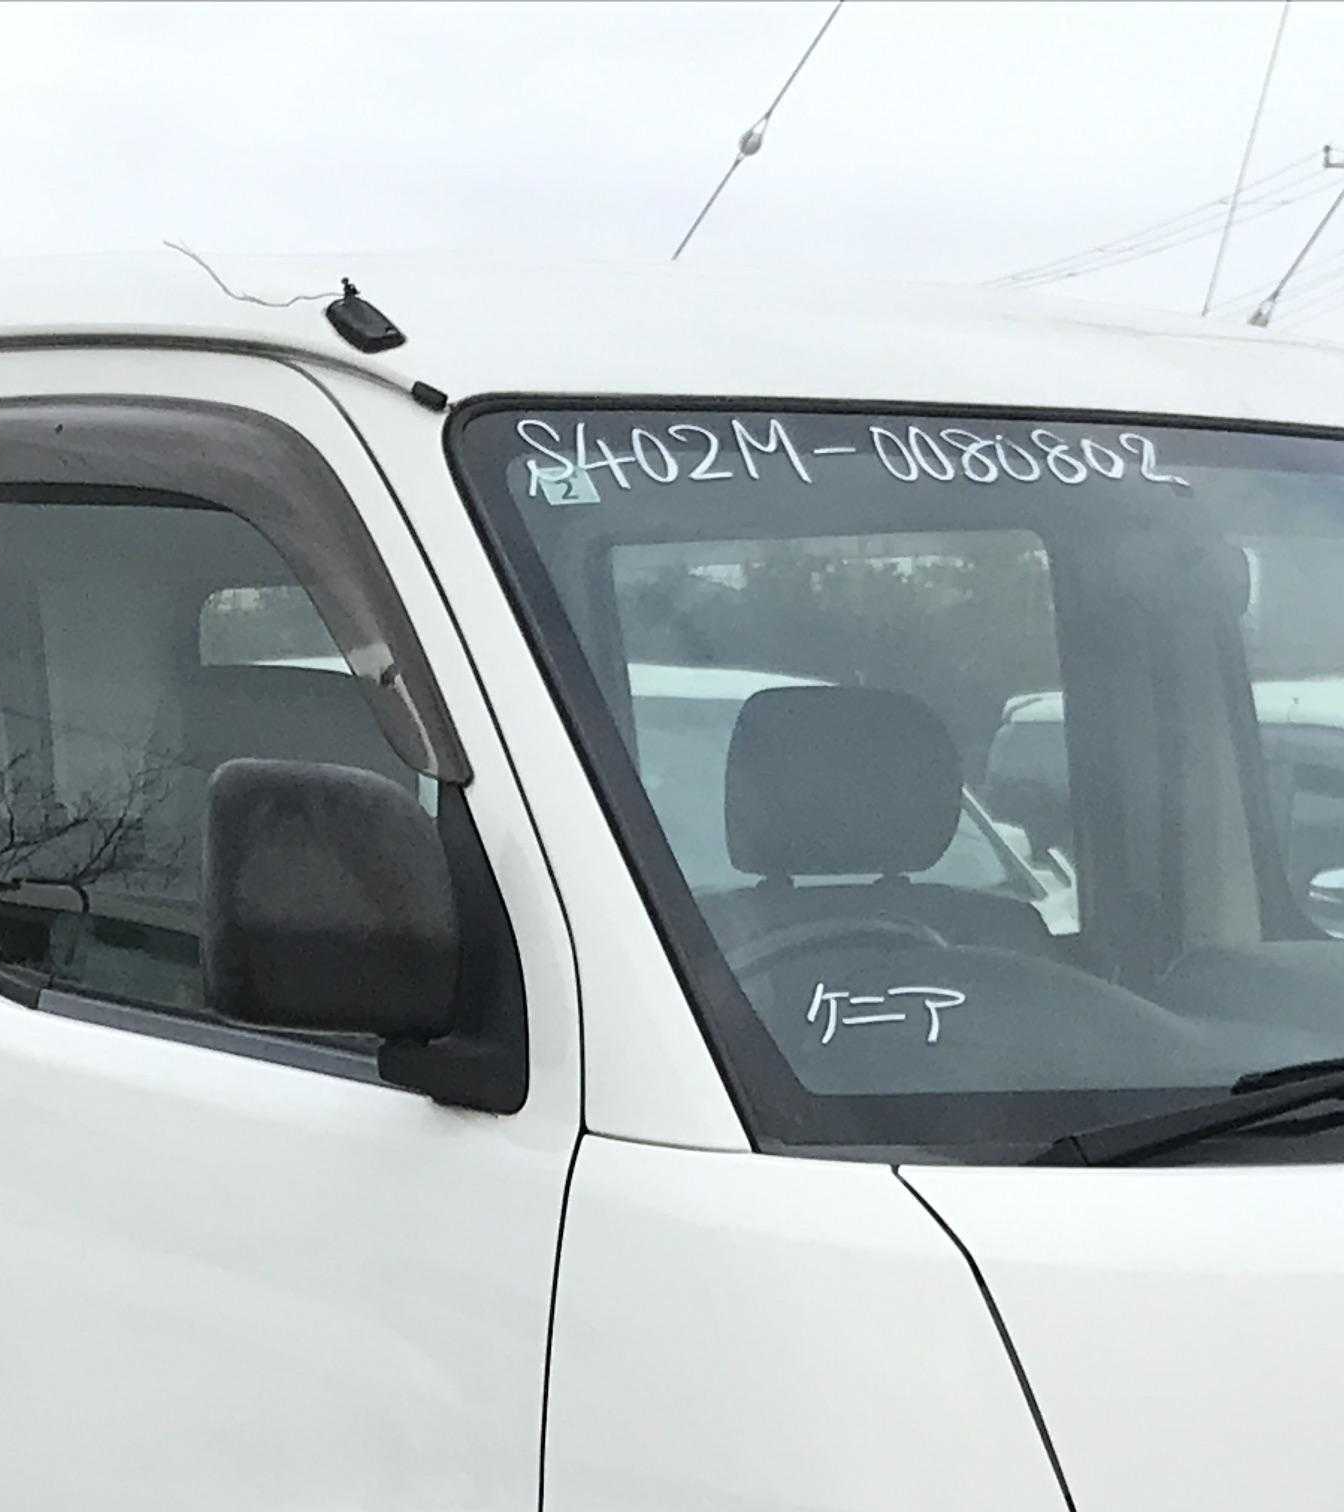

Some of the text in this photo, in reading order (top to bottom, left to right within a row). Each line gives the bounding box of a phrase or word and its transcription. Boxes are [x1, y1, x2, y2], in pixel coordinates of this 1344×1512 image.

[517, 419, 1190, 497] S402M-0080802
[807, 982, 966, 1044] ケニア
